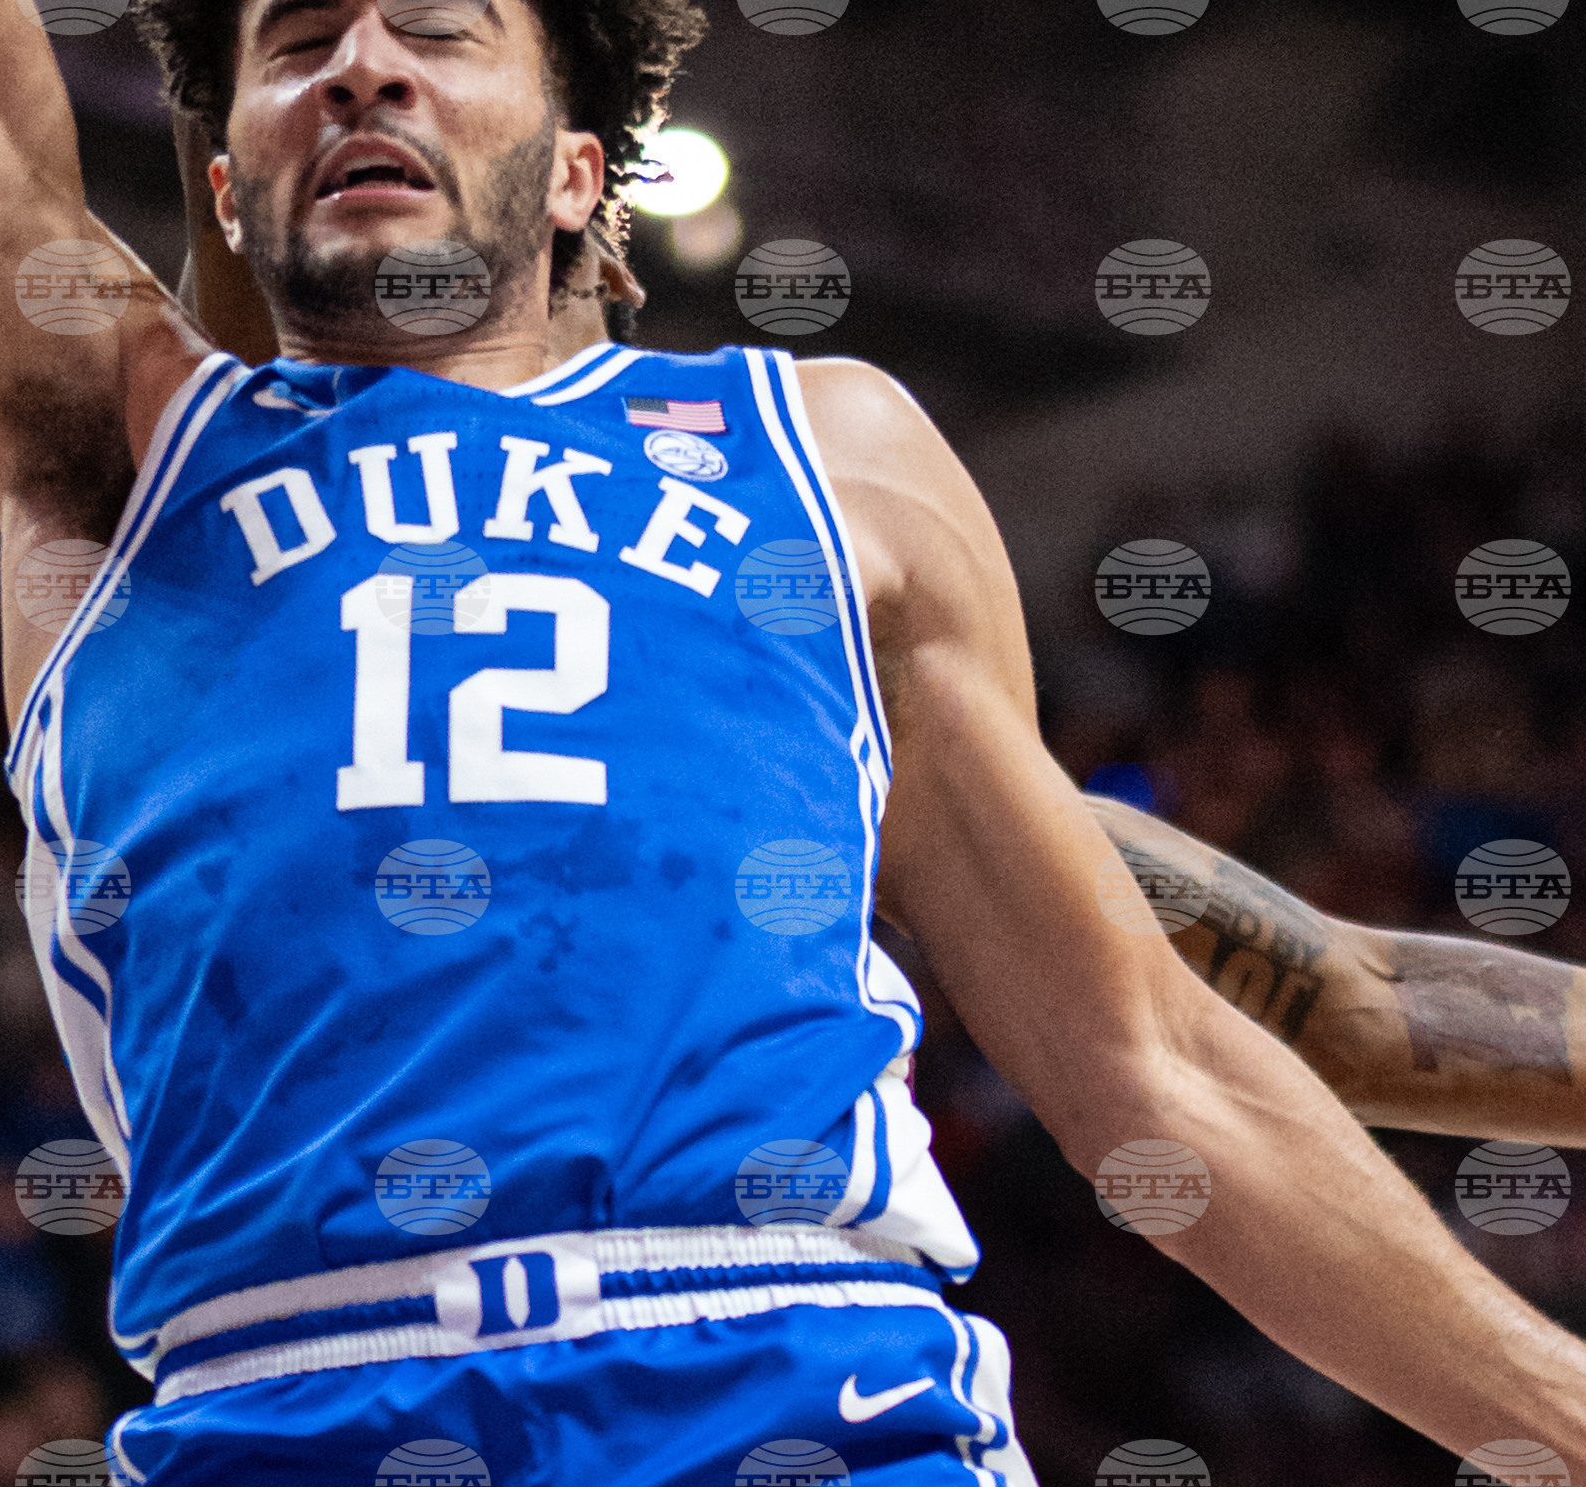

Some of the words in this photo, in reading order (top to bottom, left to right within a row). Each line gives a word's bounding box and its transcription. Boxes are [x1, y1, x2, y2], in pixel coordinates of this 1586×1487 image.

[221, 431, 751, 599] DUKE
[337, 573, 610, 811] 12
[470, 1250, 560, 1338] D
